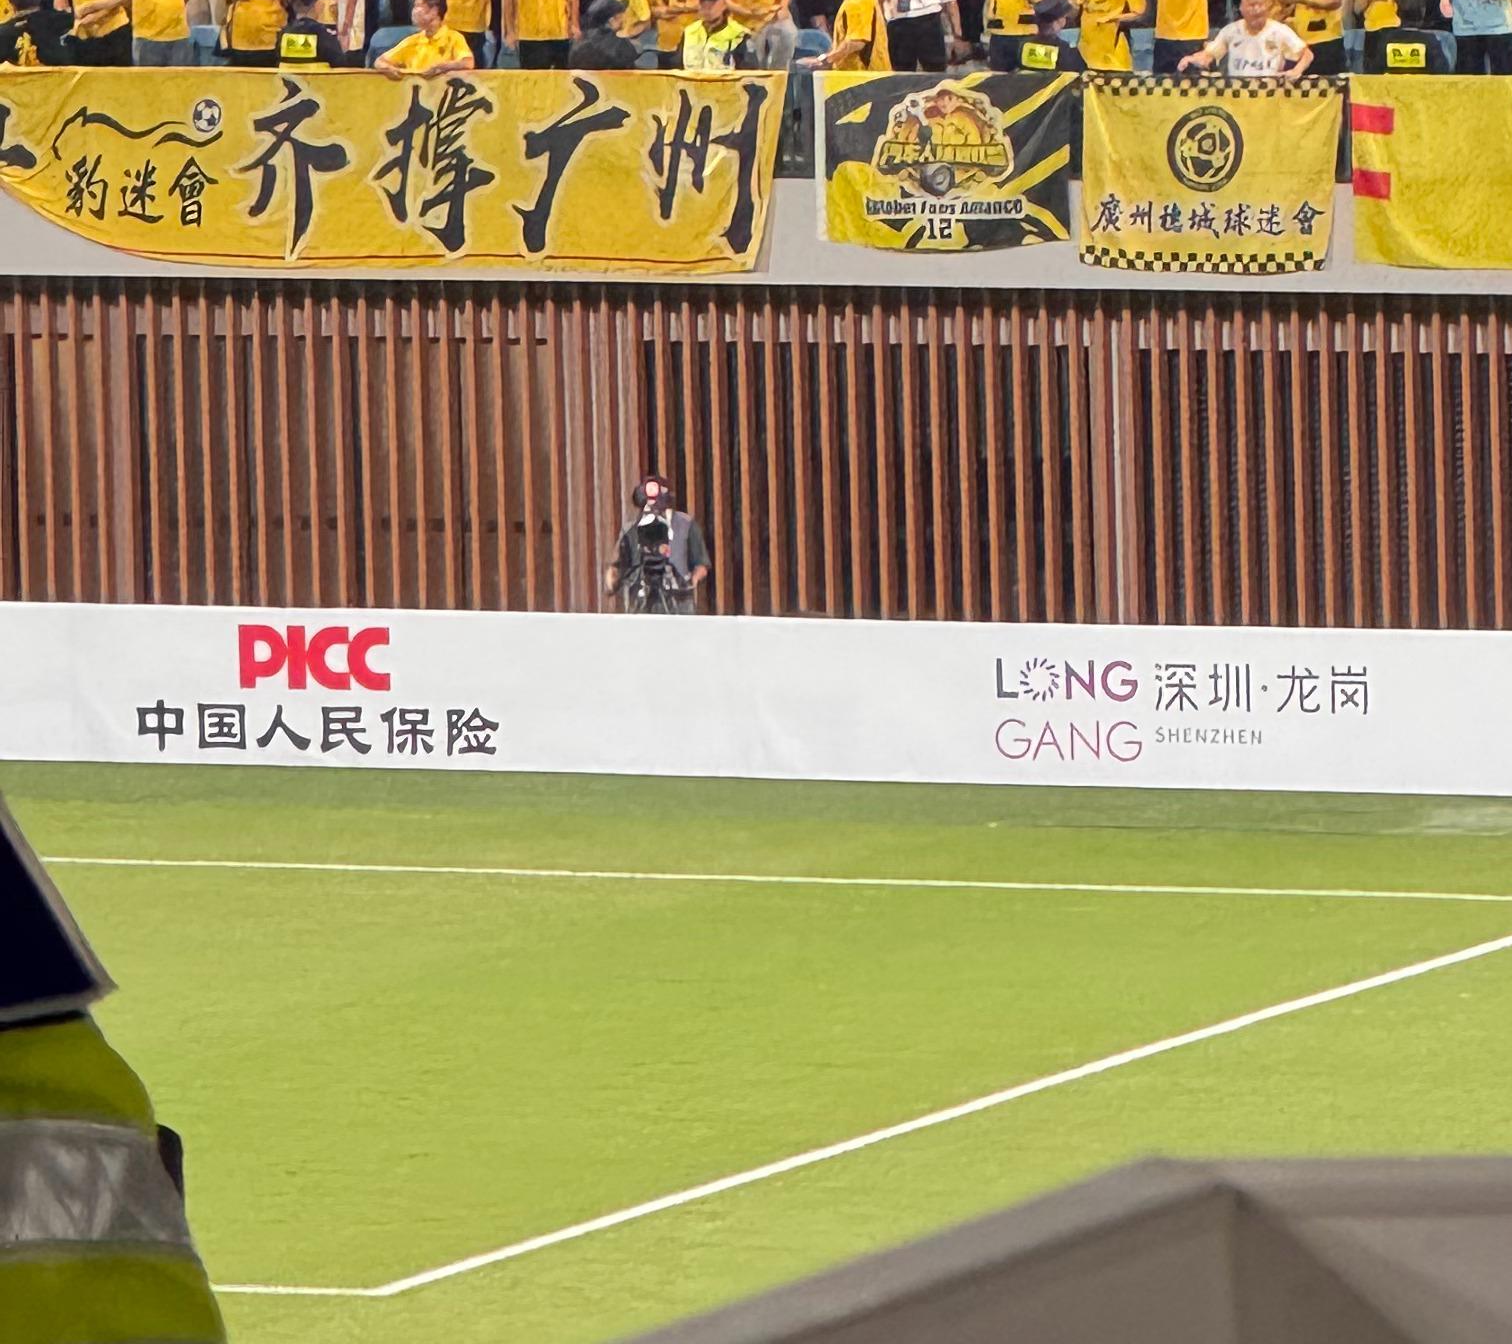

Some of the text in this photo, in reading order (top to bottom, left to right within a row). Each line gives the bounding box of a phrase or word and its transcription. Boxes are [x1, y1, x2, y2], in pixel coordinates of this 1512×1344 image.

[65, 154, 219, 228] 豹迷會
[238, 624, 391, 691] PICC
[996, 657, 1139, 702] LONG
[136, 699, 499, 757] 中国人民保险
[995, 719, 1142, 762] GANG
[1155, 727, 1263, 745] SHENZHEN
